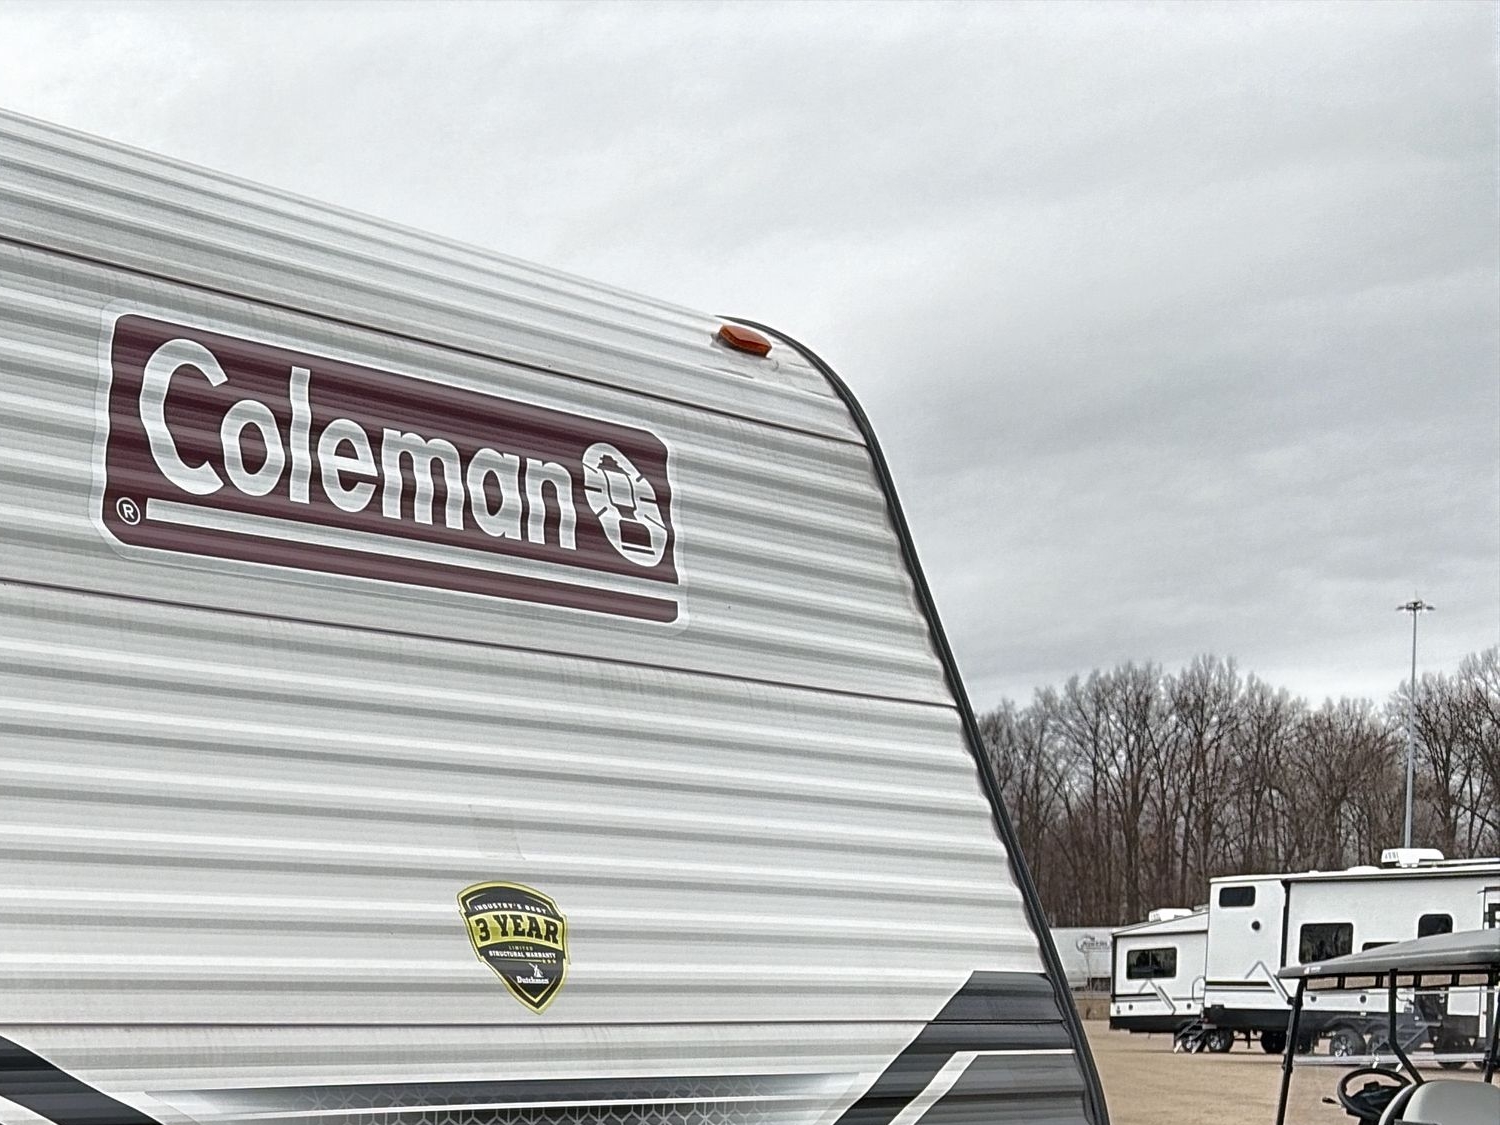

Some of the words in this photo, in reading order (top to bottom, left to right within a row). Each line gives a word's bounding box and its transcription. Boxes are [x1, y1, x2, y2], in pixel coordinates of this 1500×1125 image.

[139, 338, 577, 551] Coleman
[475, 918, 490, 942] 3
[493, 914, 559, 944] YEAR
